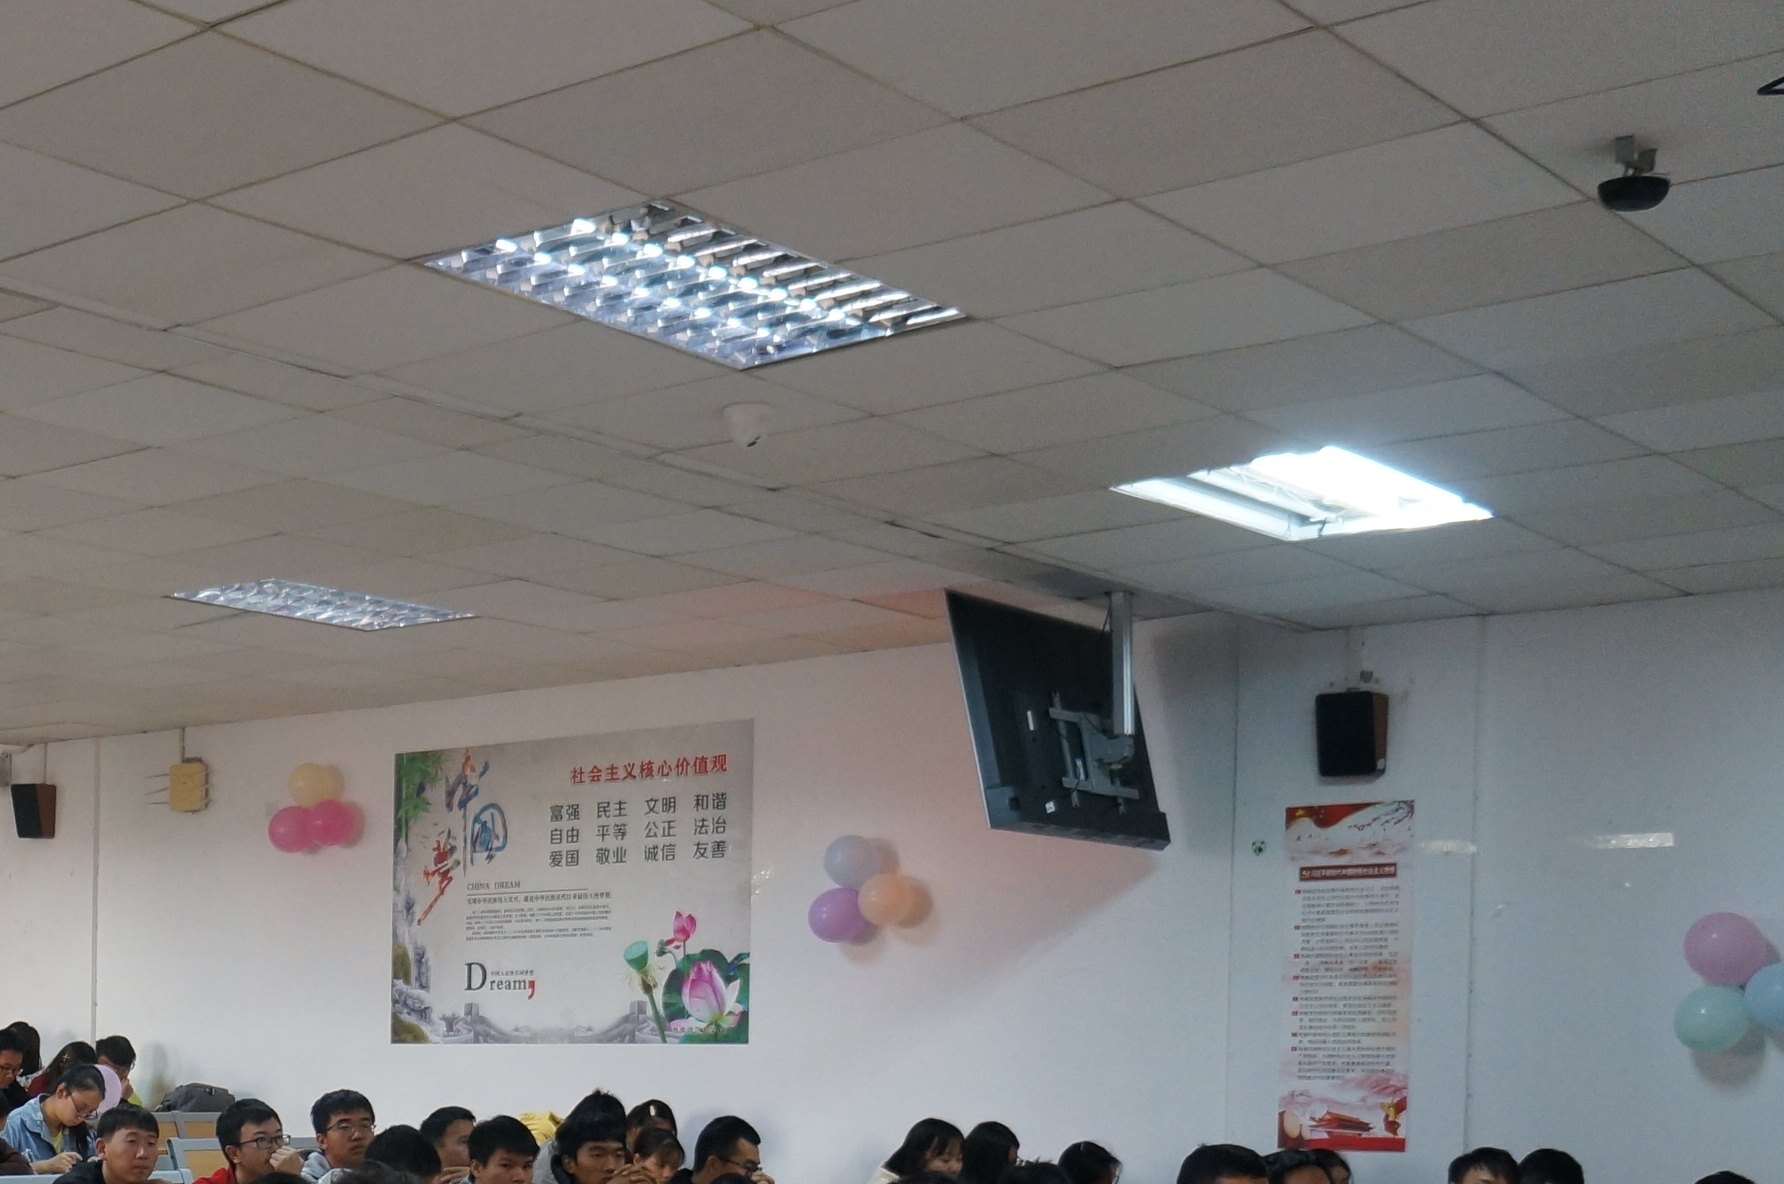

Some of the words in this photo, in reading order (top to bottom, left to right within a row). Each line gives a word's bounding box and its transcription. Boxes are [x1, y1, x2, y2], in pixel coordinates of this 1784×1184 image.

[571, 754, 727, 784] 社会主义核心价值观
[549, 804, 580, 822] 富强
[596, 800, 627, 818] 民主
[644, 796, 676, 815] 文明
[693, 792, 727, 812] 和谐
[549, 827, 579, 845] 自由
[596, 823, 627, 842] 平等
[644, 820, 677, 839] 公正
[693, 816, 726, 836] 法治
[549, 849, 579, 868] 爱国
[595, 846, 627, 865] 敬业
[644, 843, 676, 862] 诚信
[692, 840, 727, 860] 友善
[466, 882, 490, 891] CHINA
[493, 880, 521, 890] DREAM
